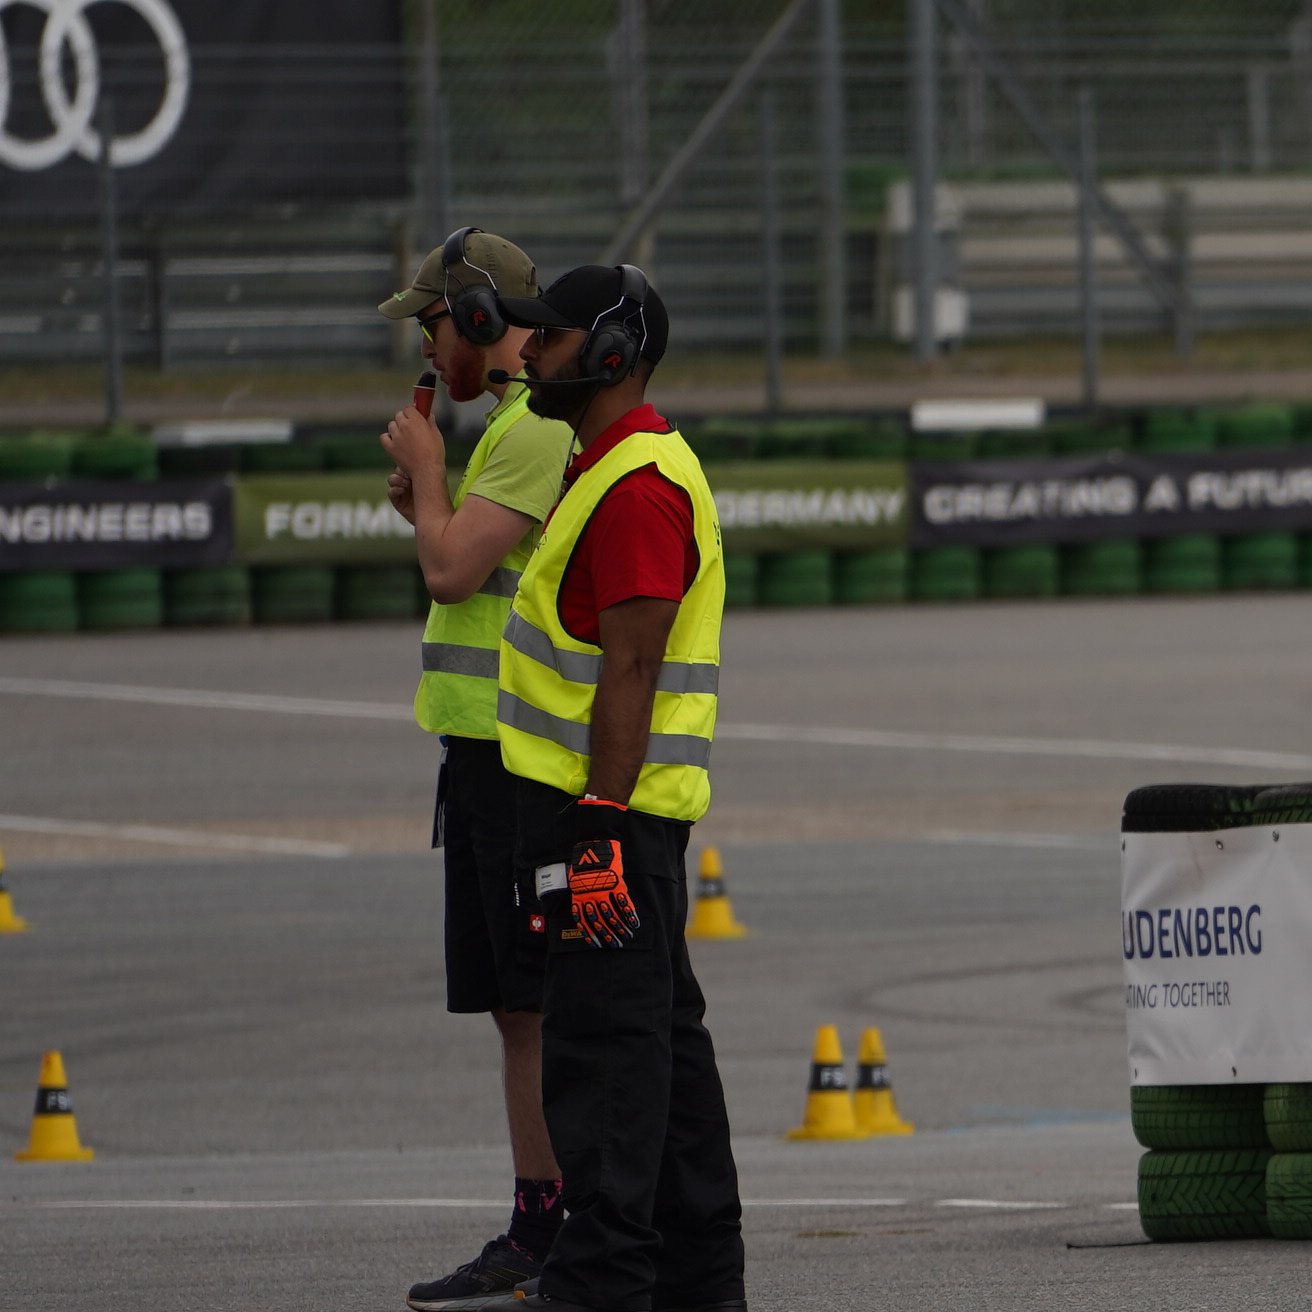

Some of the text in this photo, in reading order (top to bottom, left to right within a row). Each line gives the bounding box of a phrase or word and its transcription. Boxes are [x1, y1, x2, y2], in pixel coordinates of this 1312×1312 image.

[923, 476, 1140, 526] CREATING
[1144, 472, 1181, 512] A
[1162, 980, 1232, 1009] TOGETHER
